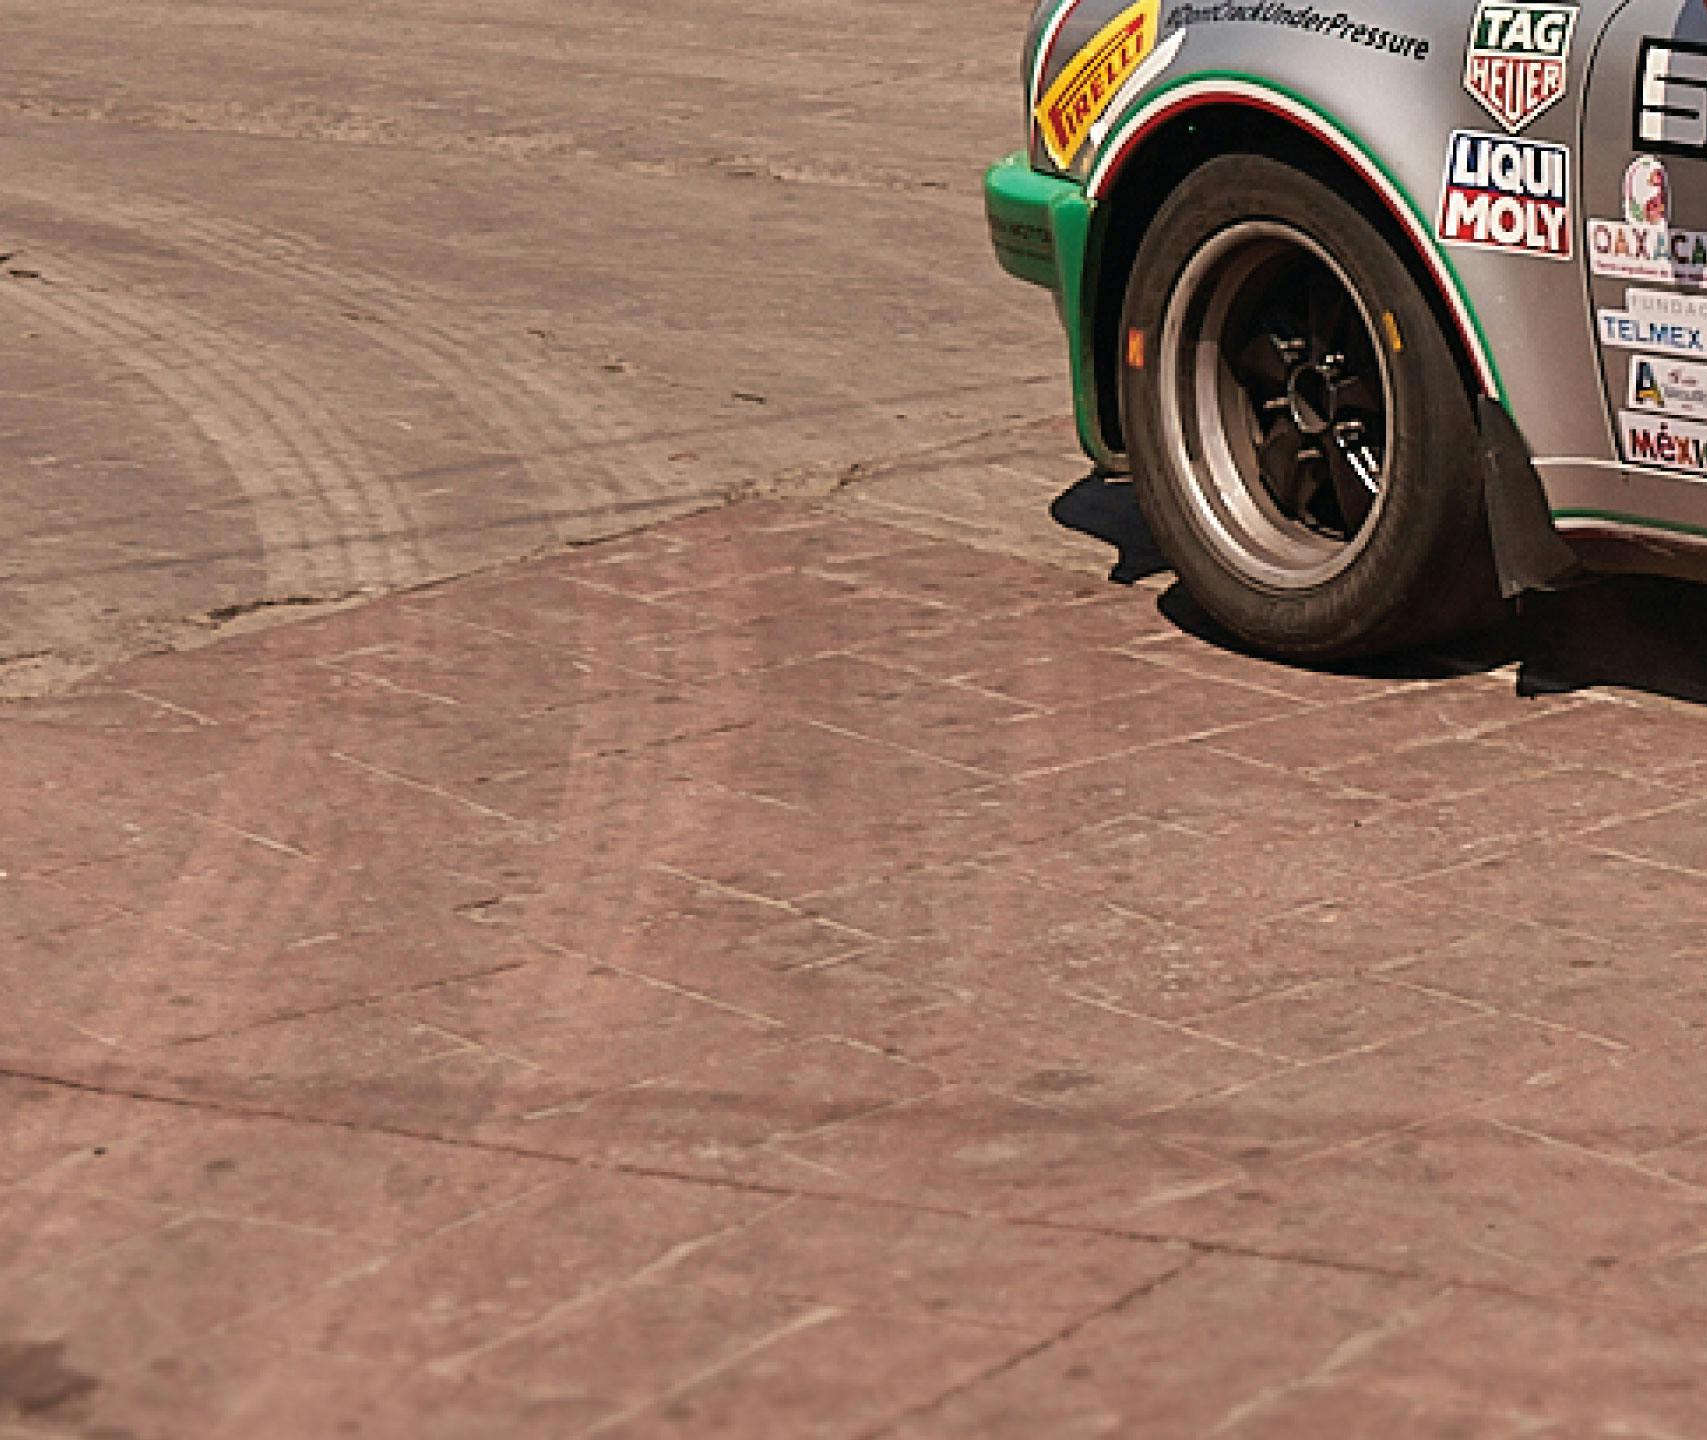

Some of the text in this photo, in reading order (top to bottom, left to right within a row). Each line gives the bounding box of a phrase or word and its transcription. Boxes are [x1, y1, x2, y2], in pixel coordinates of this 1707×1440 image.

[1483, 8, 1566, 53] TAG
[1047, 13, 1147, 151] PIRELLI
[1470, 58, 1563, 123] HEUER
[1452, 136, 1567, 200] LIQUI
[1443, 192, 1565, 252] MOLY
[1603, 316, 1703, 352] TELMEX
